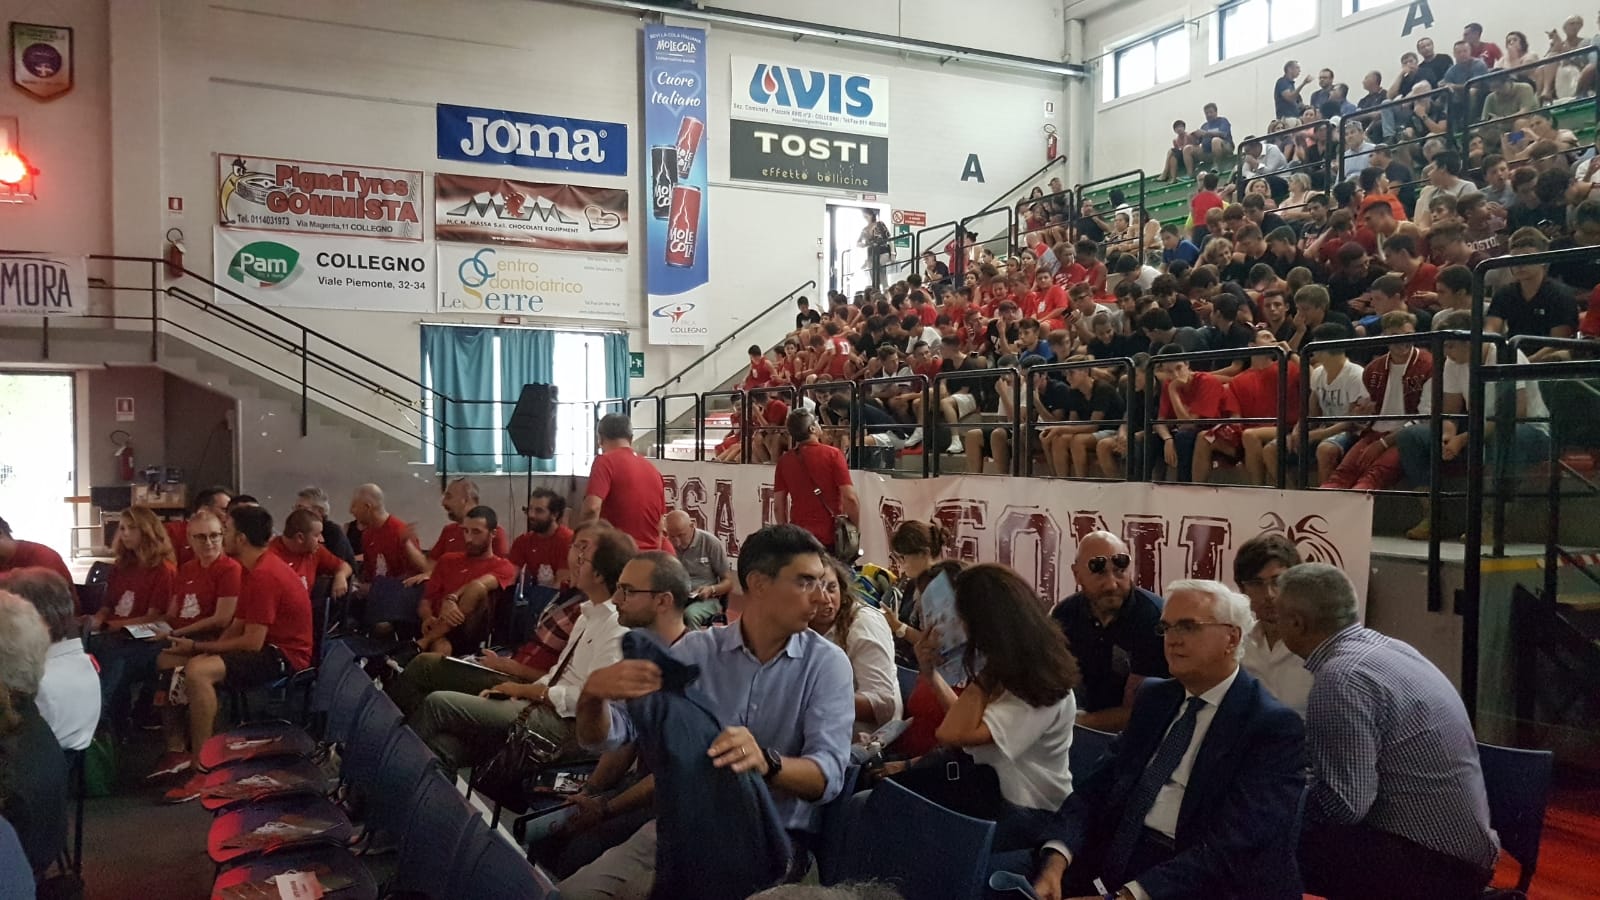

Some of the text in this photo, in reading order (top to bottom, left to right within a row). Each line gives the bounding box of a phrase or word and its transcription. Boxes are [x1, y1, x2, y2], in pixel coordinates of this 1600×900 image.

[1401, 0, 1434, 37] A
[657, 71, 695, 87] Cuore
[651, 90, 701, 107] Italiano
[749, 63, 874, 118] AVIS
[753, 130, 869, 165] TOSTI
[762, 167, 869, 187] effetto bollicine
[961, 153, 986, 183] A
[266, 190, 419, 224] GOMMISTA
[250, 216, 290, 226] 0114031973
[296, 219, 308, 228] Via
[351, 224, 393, 233] COLLEGNO
[508, 223, 543, 231] CHOCOLATE
[240, 252, 288, 274] Pam
[316, 252, 426, 273] COLLEGNO
[318, 276, 343, 286] Viale
[398, 280, 426, 290] 32-34
[441, 291, 462, 309] Le
[670, 326, 708, 334] COLLEGNO
